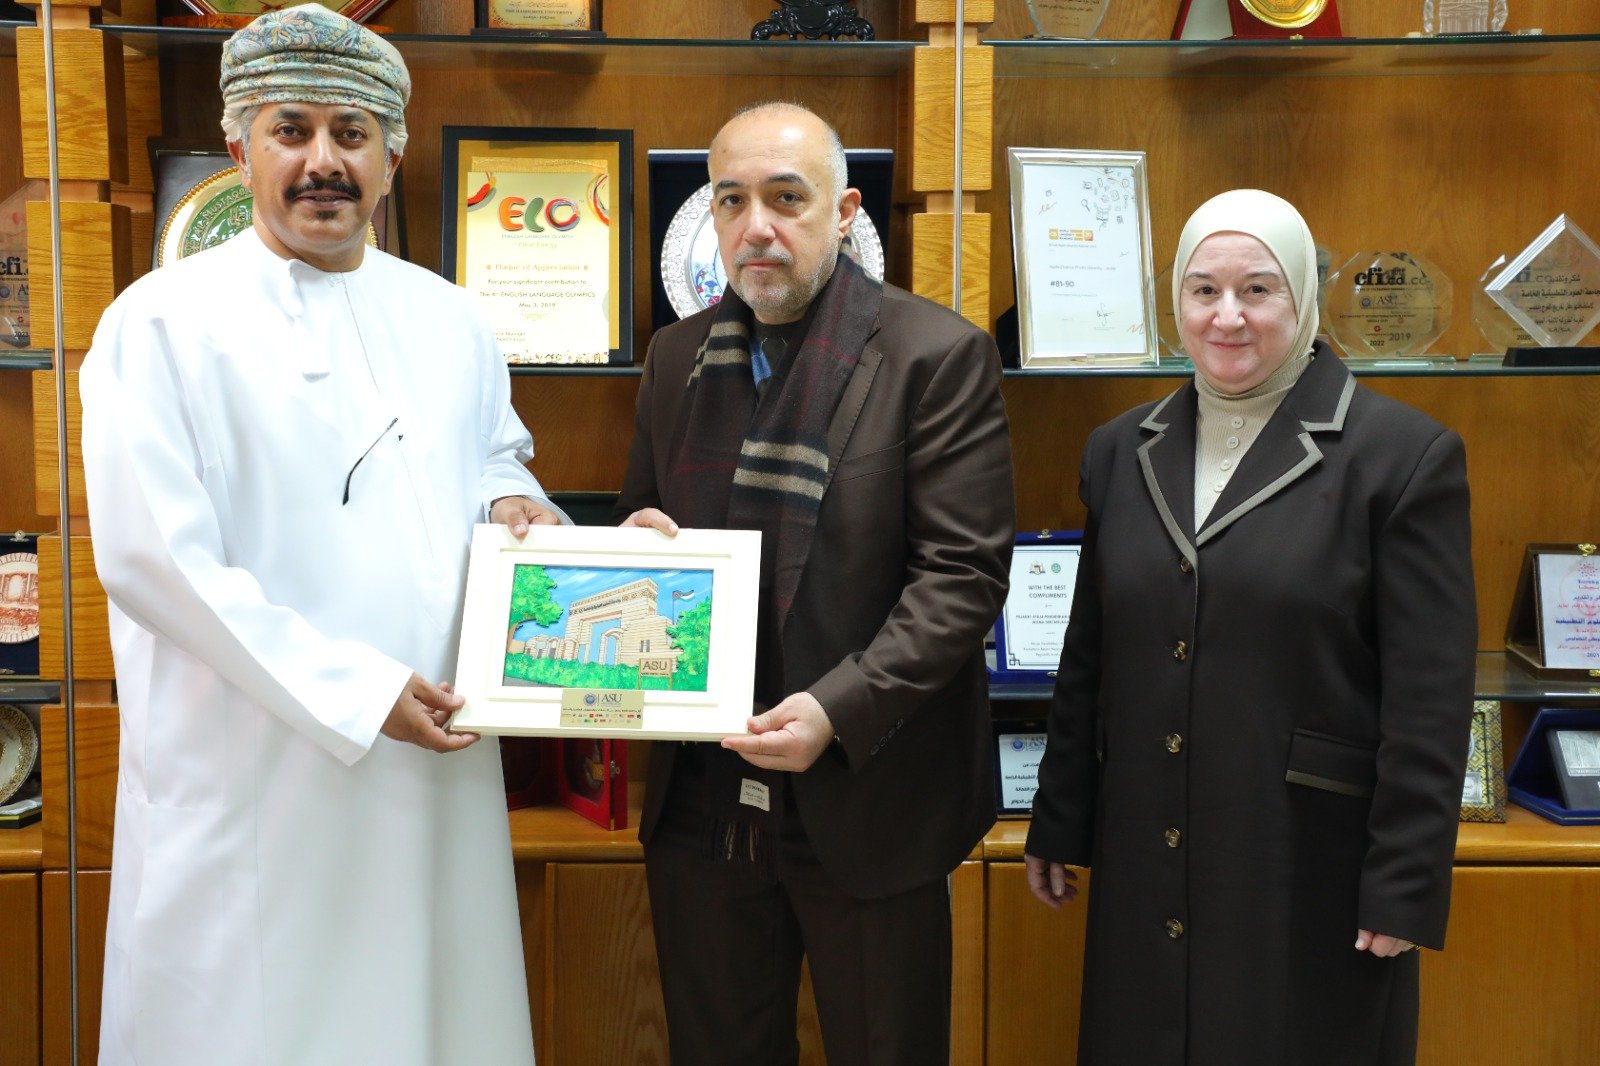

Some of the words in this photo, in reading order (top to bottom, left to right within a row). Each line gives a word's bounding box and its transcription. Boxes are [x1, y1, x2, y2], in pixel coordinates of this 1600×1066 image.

[1050, 280, 1075, 288] #81-90
[642, 661, 668, 671] ASU
[602, 693, 623, 703] ASU
